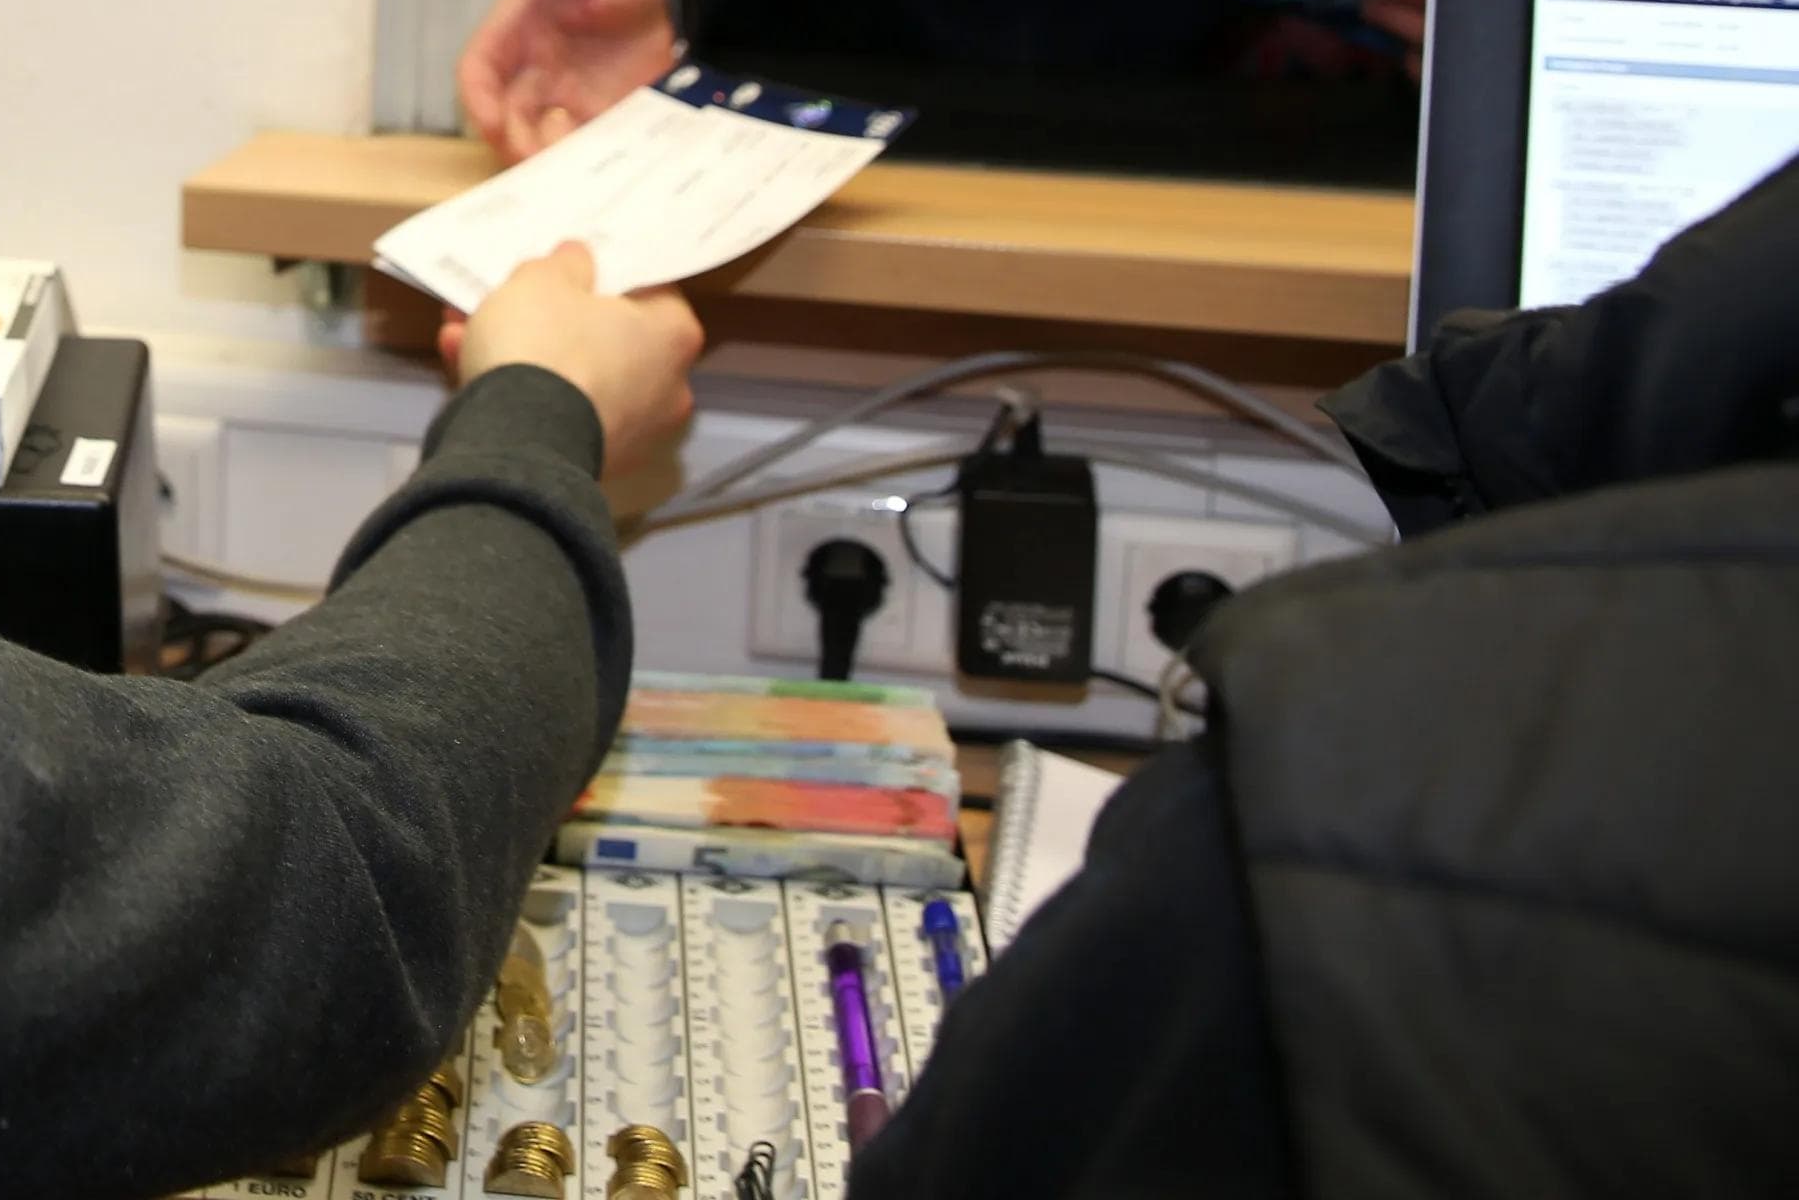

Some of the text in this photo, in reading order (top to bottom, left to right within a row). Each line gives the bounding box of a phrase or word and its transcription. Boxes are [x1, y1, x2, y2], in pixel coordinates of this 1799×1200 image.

[694, 846, 727, 875] 5
[248, 1182, 307, 1199] EURO
[352, 1190, 376, 1200] 50
